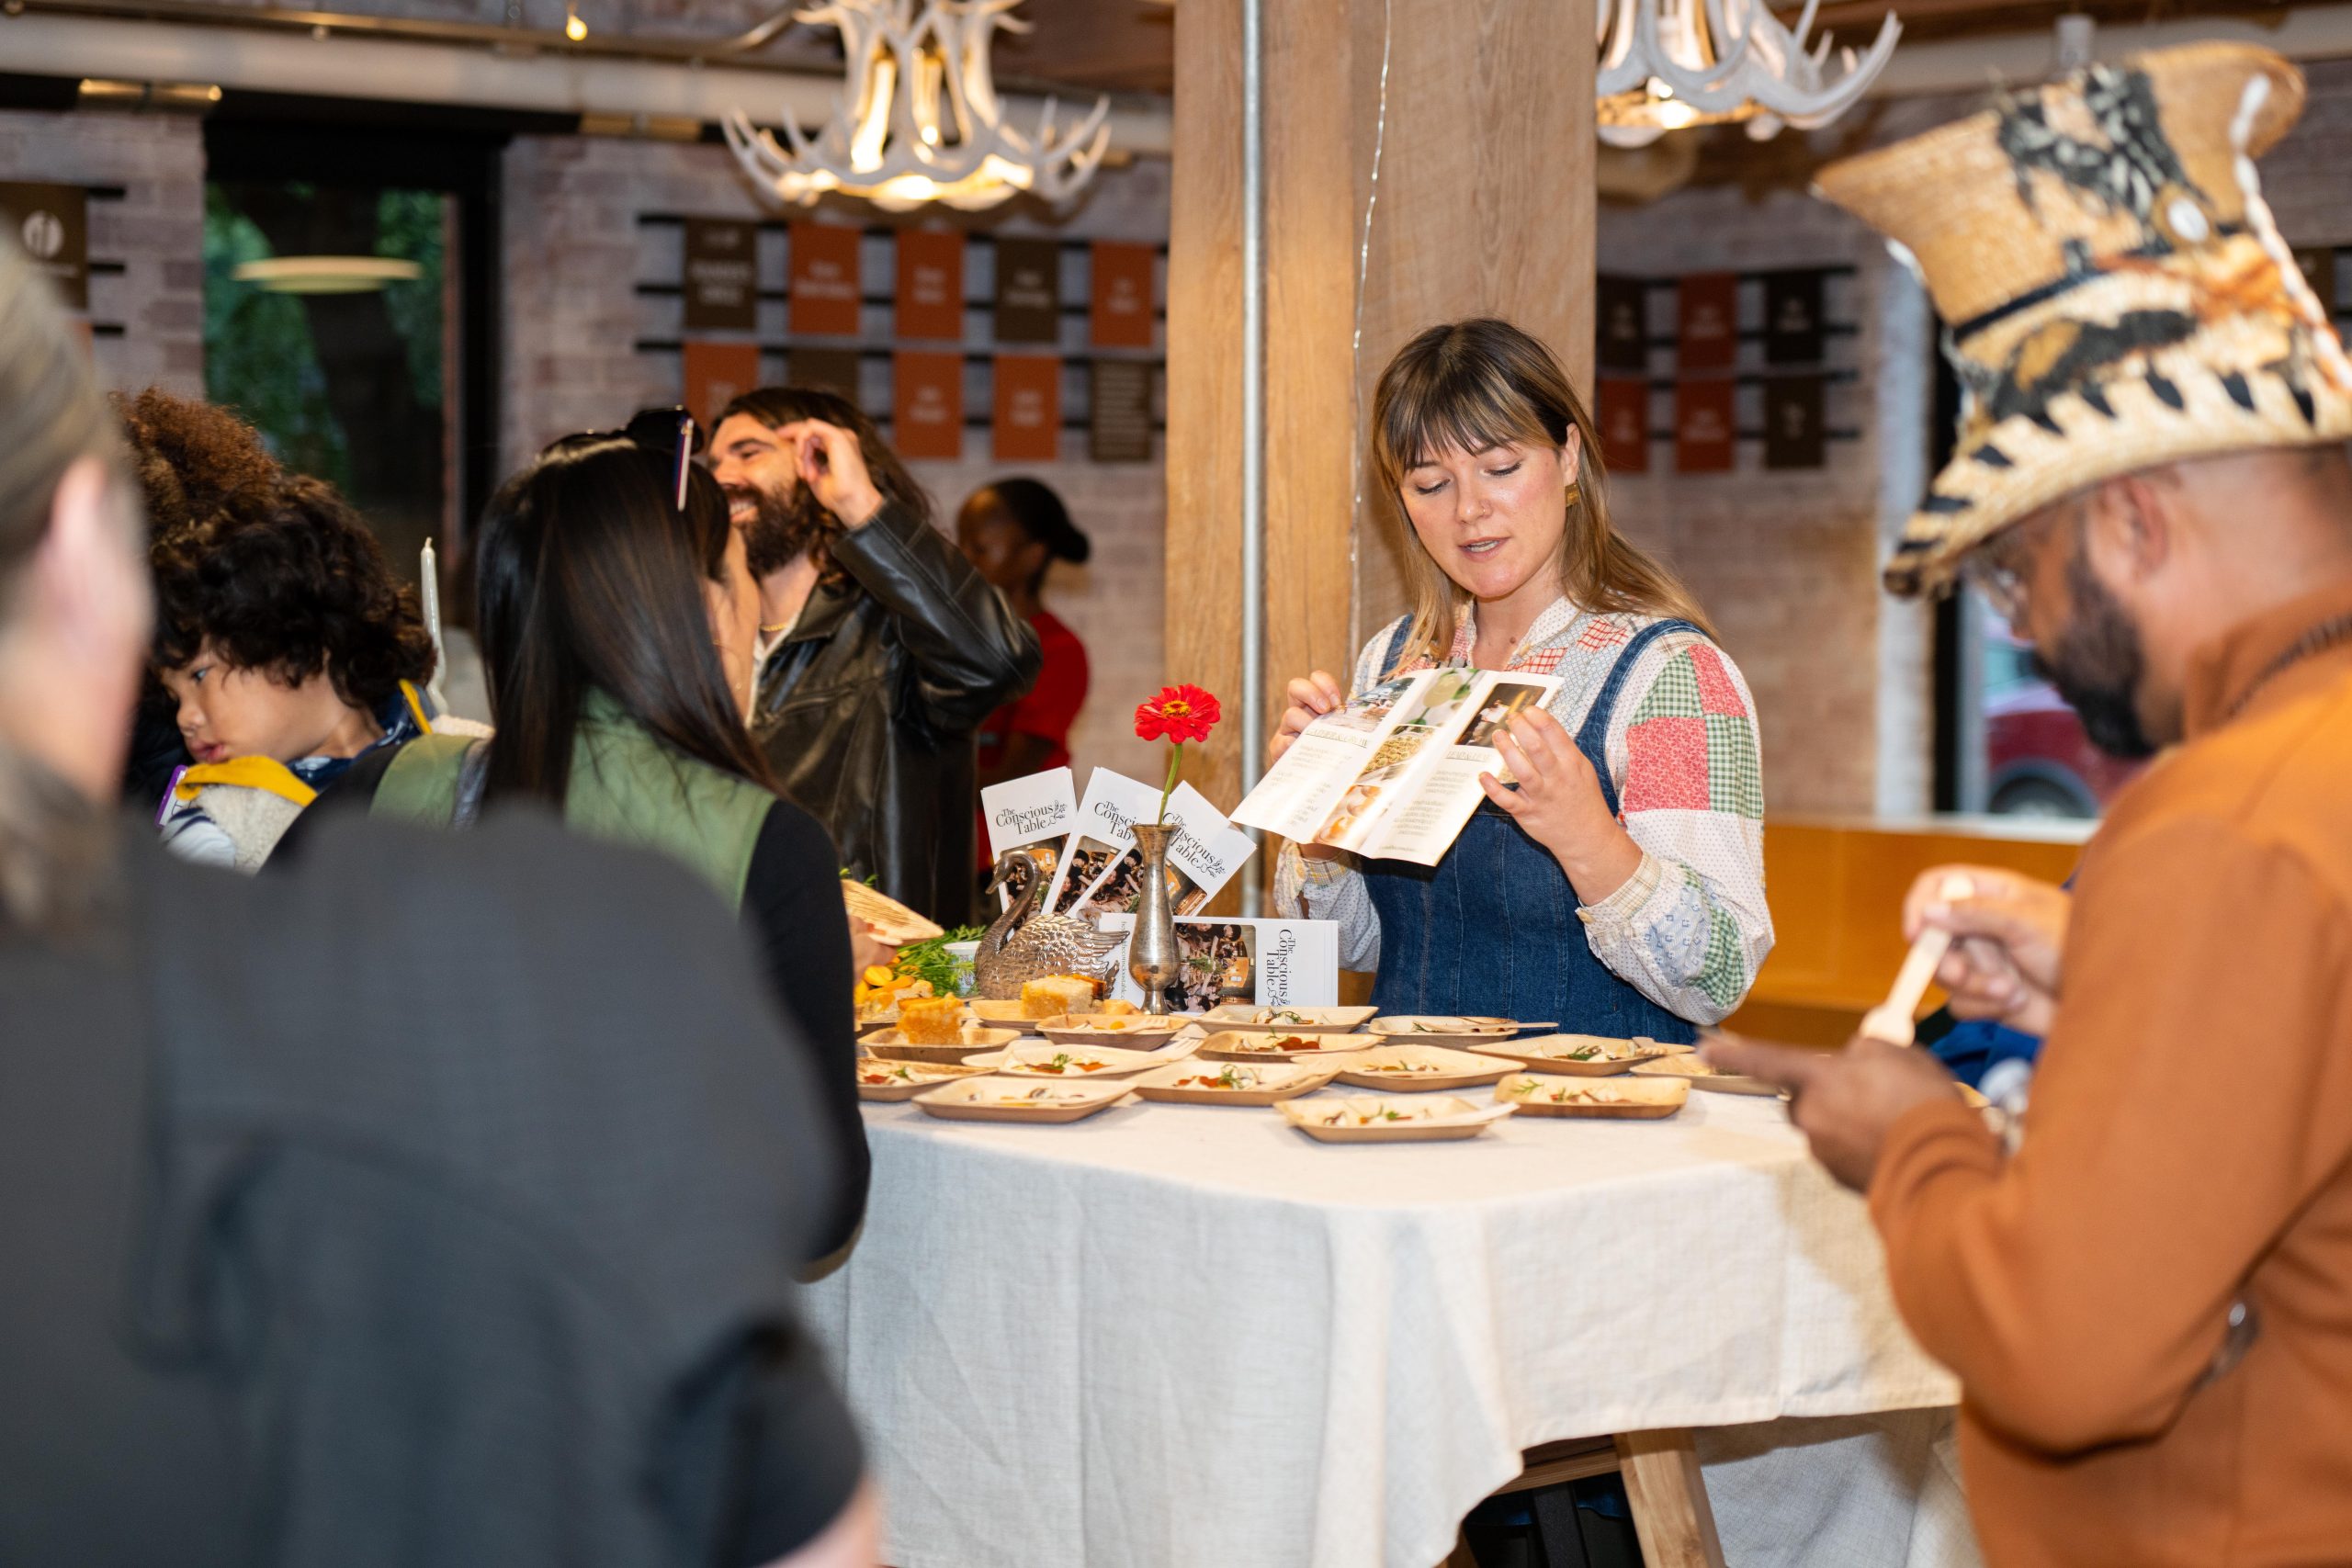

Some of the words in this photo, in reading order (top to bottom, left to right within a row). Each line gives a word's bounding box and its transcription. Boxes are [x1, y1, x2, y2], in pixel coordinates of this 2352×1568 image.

[996, 805, 1054, 828] Conscious
[1001, 808, 1015, 818] The
[1094, 802, 1141, 828] Consci
[1105, 801, 1119, 813] The
[1014, 818, 1046, 835] Table
[1110, 820, 1136, 840] Tab
[1162, 812, 1216, 864] Cnscious
[1170, 837, 1199, 866] Table
[1288, 938, 1296, 954] The
[1267, 949, 1280, 986] Table
[1279, 929, 1292, 998] Conscious
